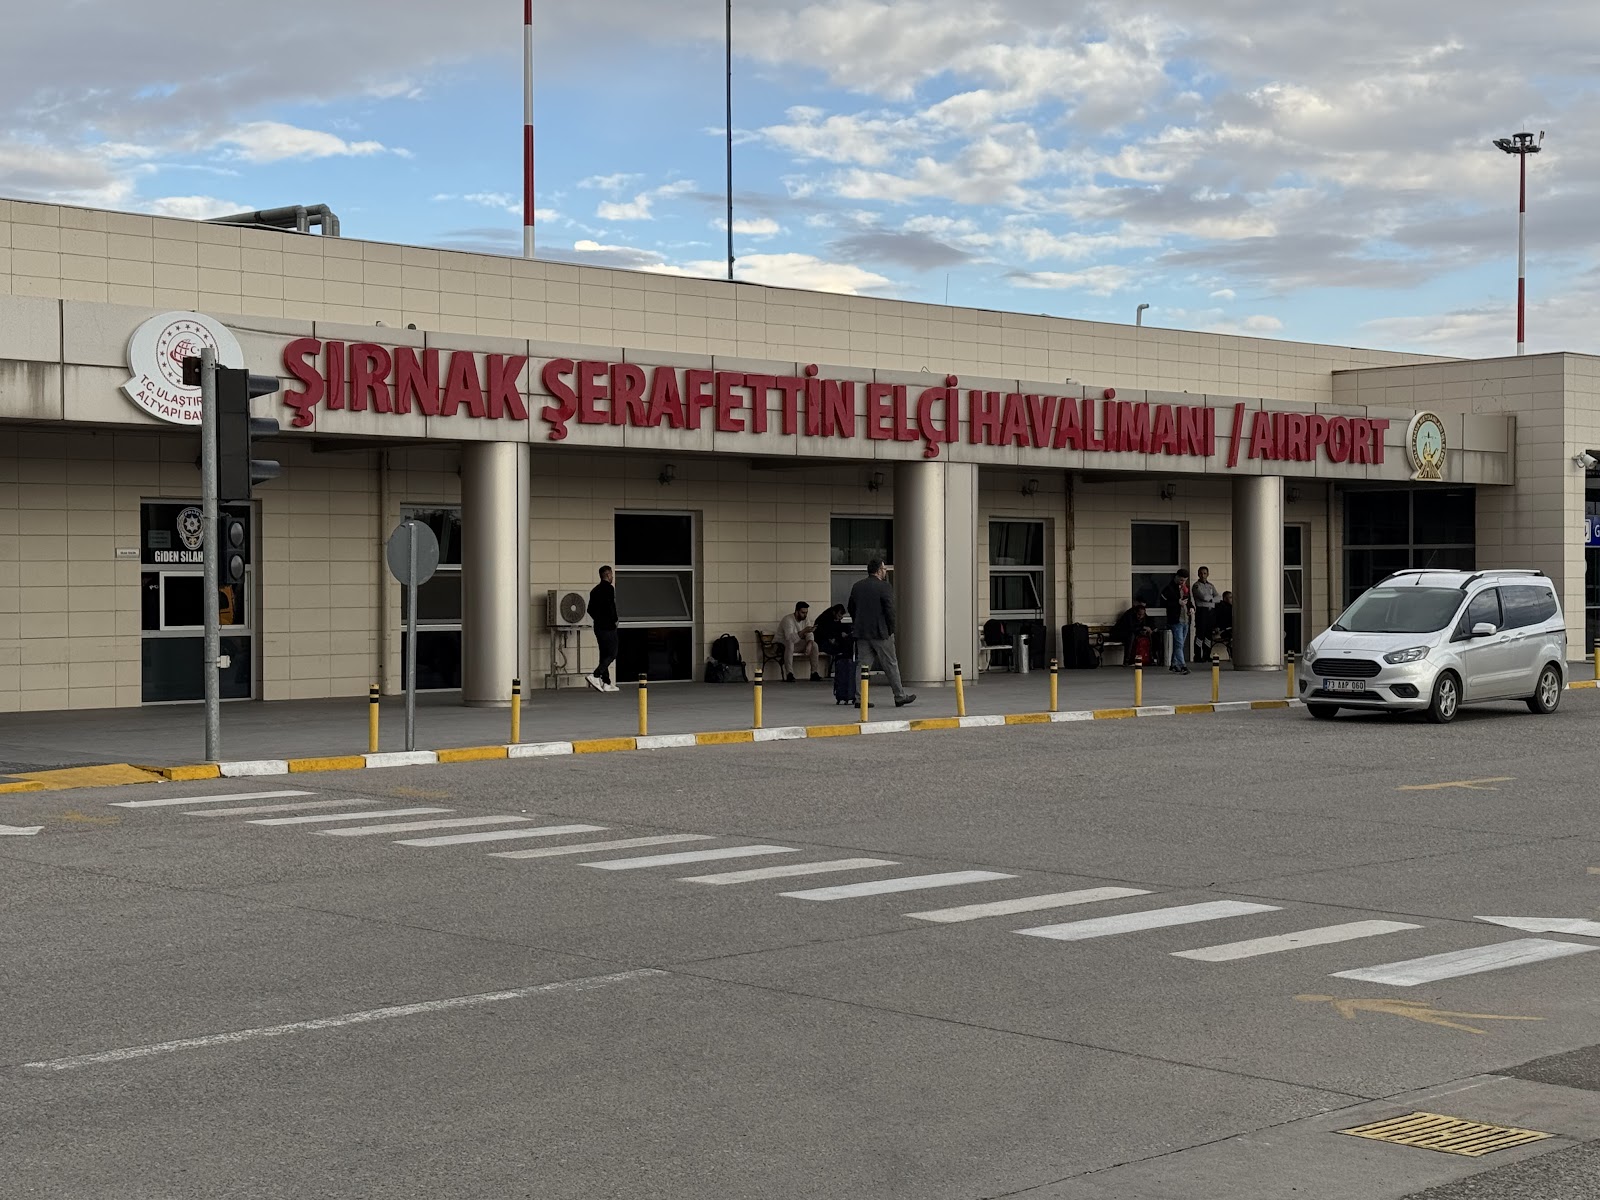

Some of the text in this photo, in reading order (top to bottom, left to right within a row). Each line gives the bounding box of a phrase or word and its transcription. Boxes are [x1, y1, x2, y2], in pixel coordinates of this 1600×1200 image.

[136, 390, 181, 418] ALTYAPI
[140, 374, 202, 407] T.C. ULAŞTIR
[283, 338, 528, 427] ŞIRNAK
[542, 358, 855, 440] ŞERAFETTİN
[866, 374, 959, 458] ELÇİ
[969, 388, 1214, 455] HAVALİMANI
[1249, 411, 1390, 464] AIRPORT
